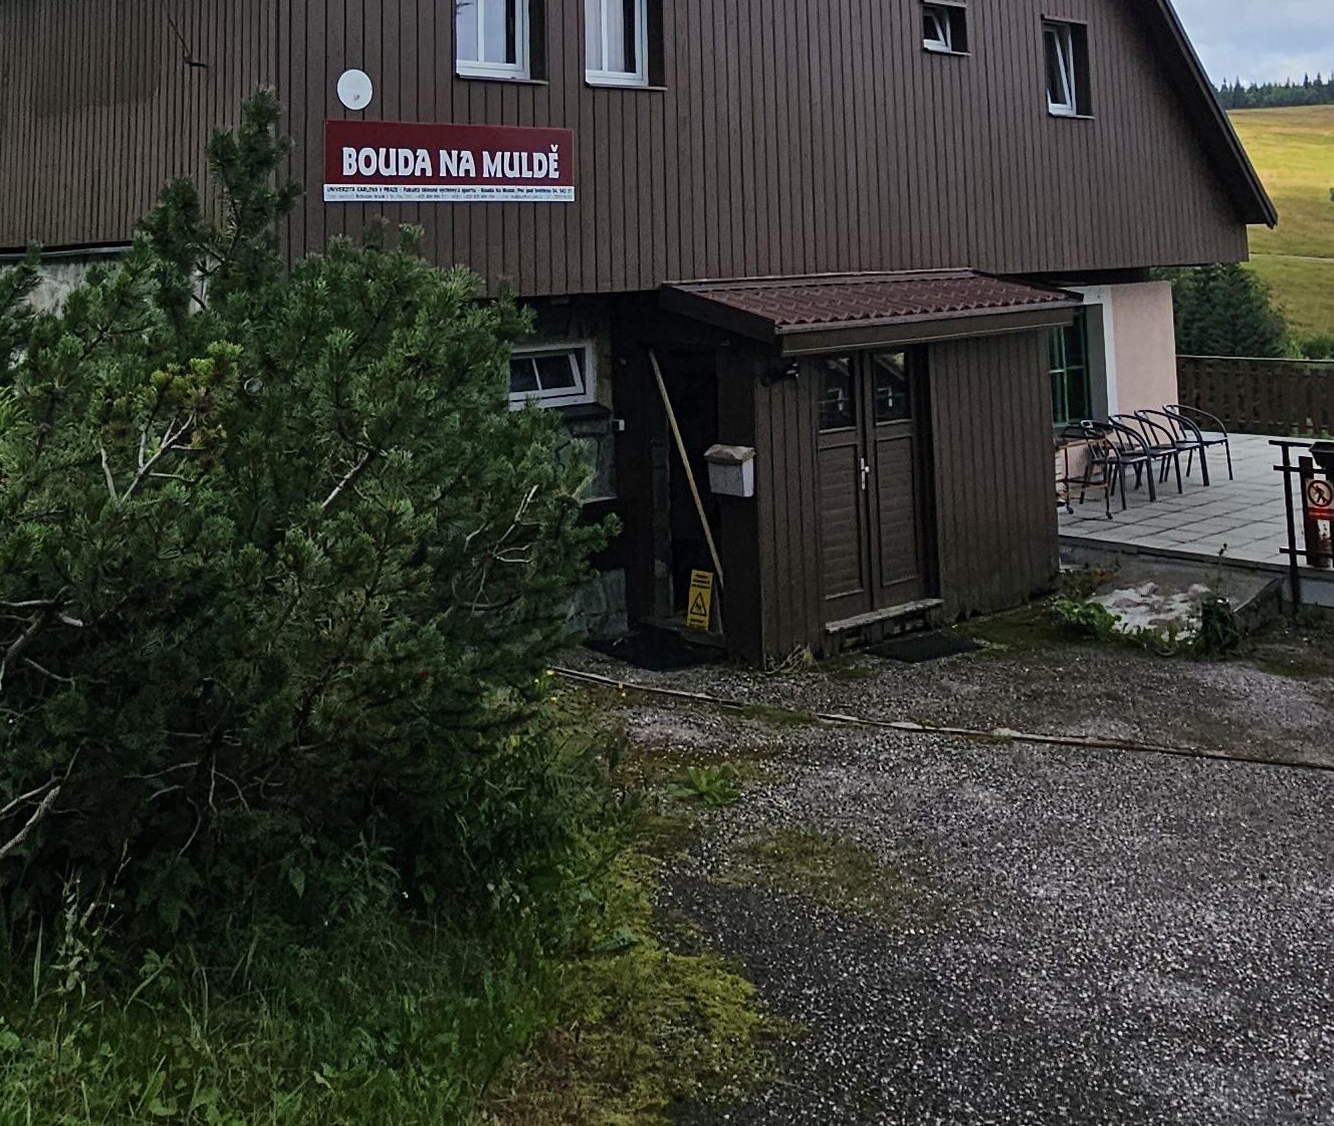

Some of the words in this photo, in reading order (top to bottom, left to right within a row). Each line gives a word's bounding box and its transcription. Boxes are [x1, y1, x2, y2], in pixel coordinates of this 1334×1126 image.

[342, 146, 433, 177] BOUDA
[439, 149, 476, 177] NA
[482, 144, 560, 179] MULDĚ
